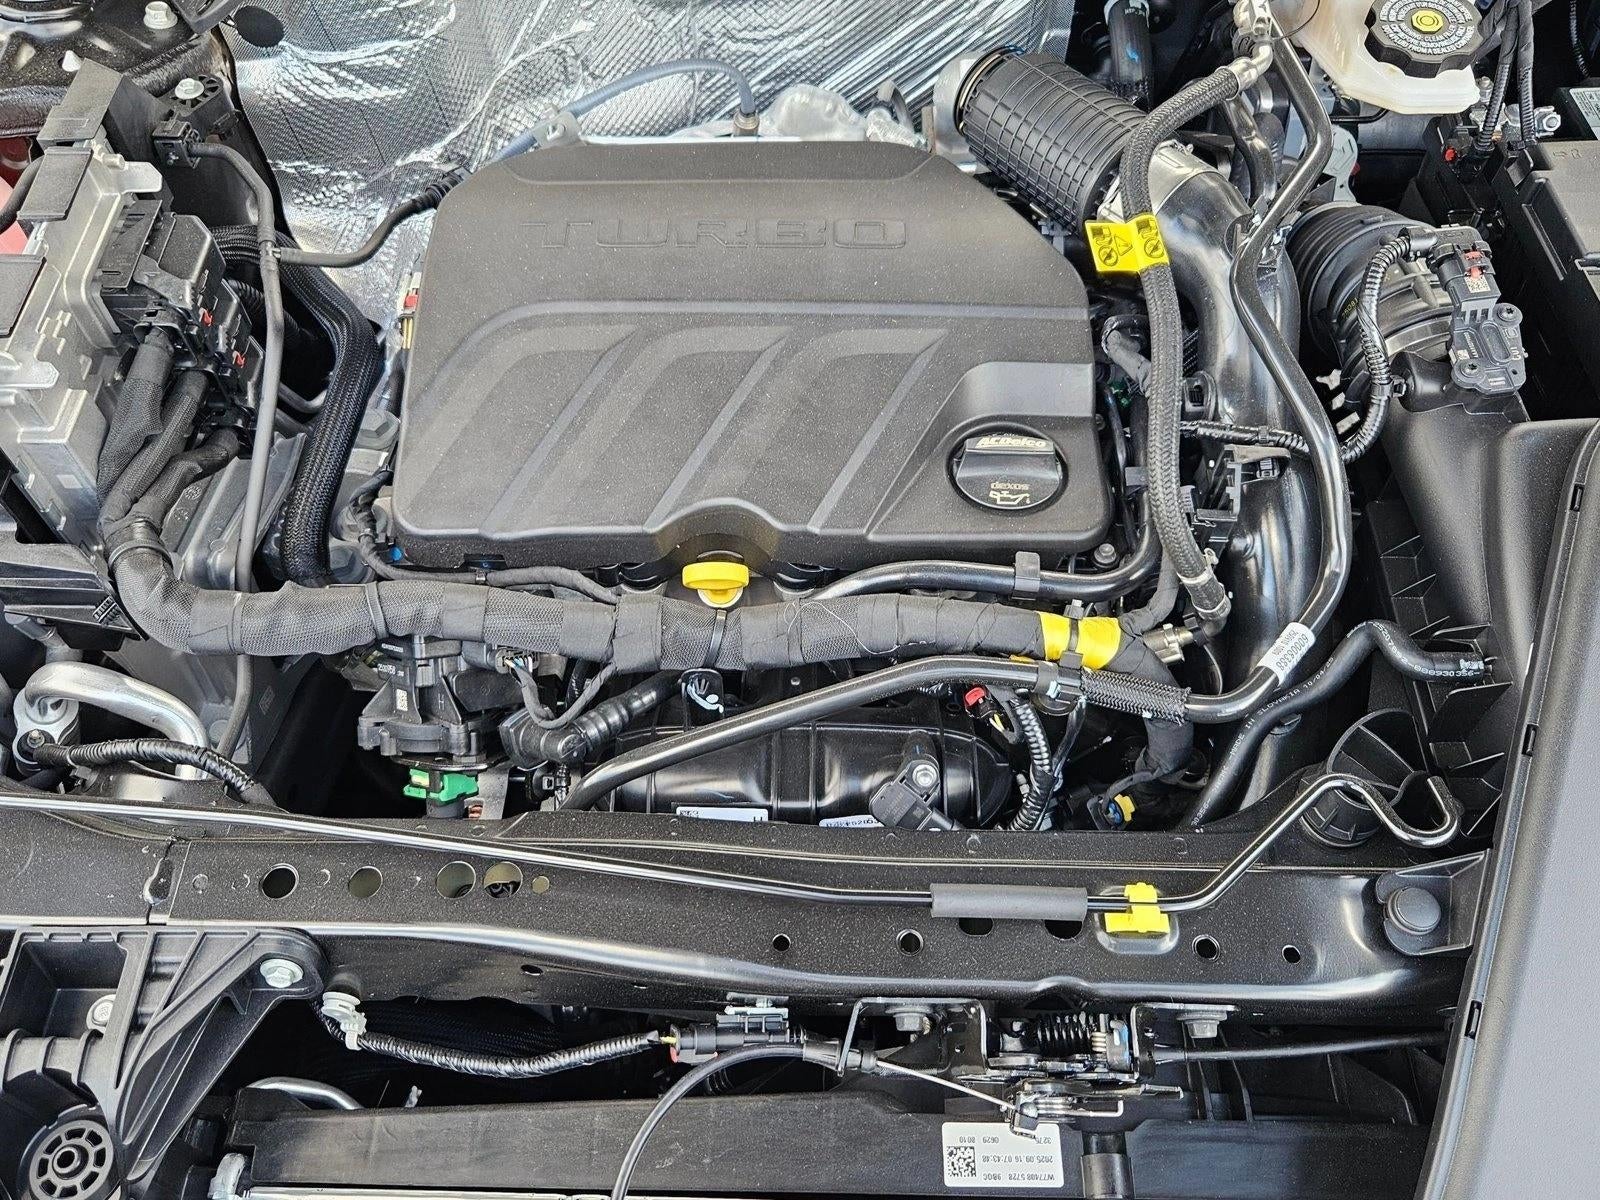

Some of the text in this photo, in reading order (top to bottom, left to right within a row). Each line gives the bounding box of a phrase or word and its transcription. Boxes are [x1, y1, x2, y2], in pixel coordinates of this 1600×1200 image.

[1408, 44, 1427, 54] FROM
[1424, 34, 1444, 43] CLEAN
[519, 217, 907, 249] TURBO
[1245, 717, 1256, 729] IN
[1257, 688, 1301, 716] SLOVAKIA
